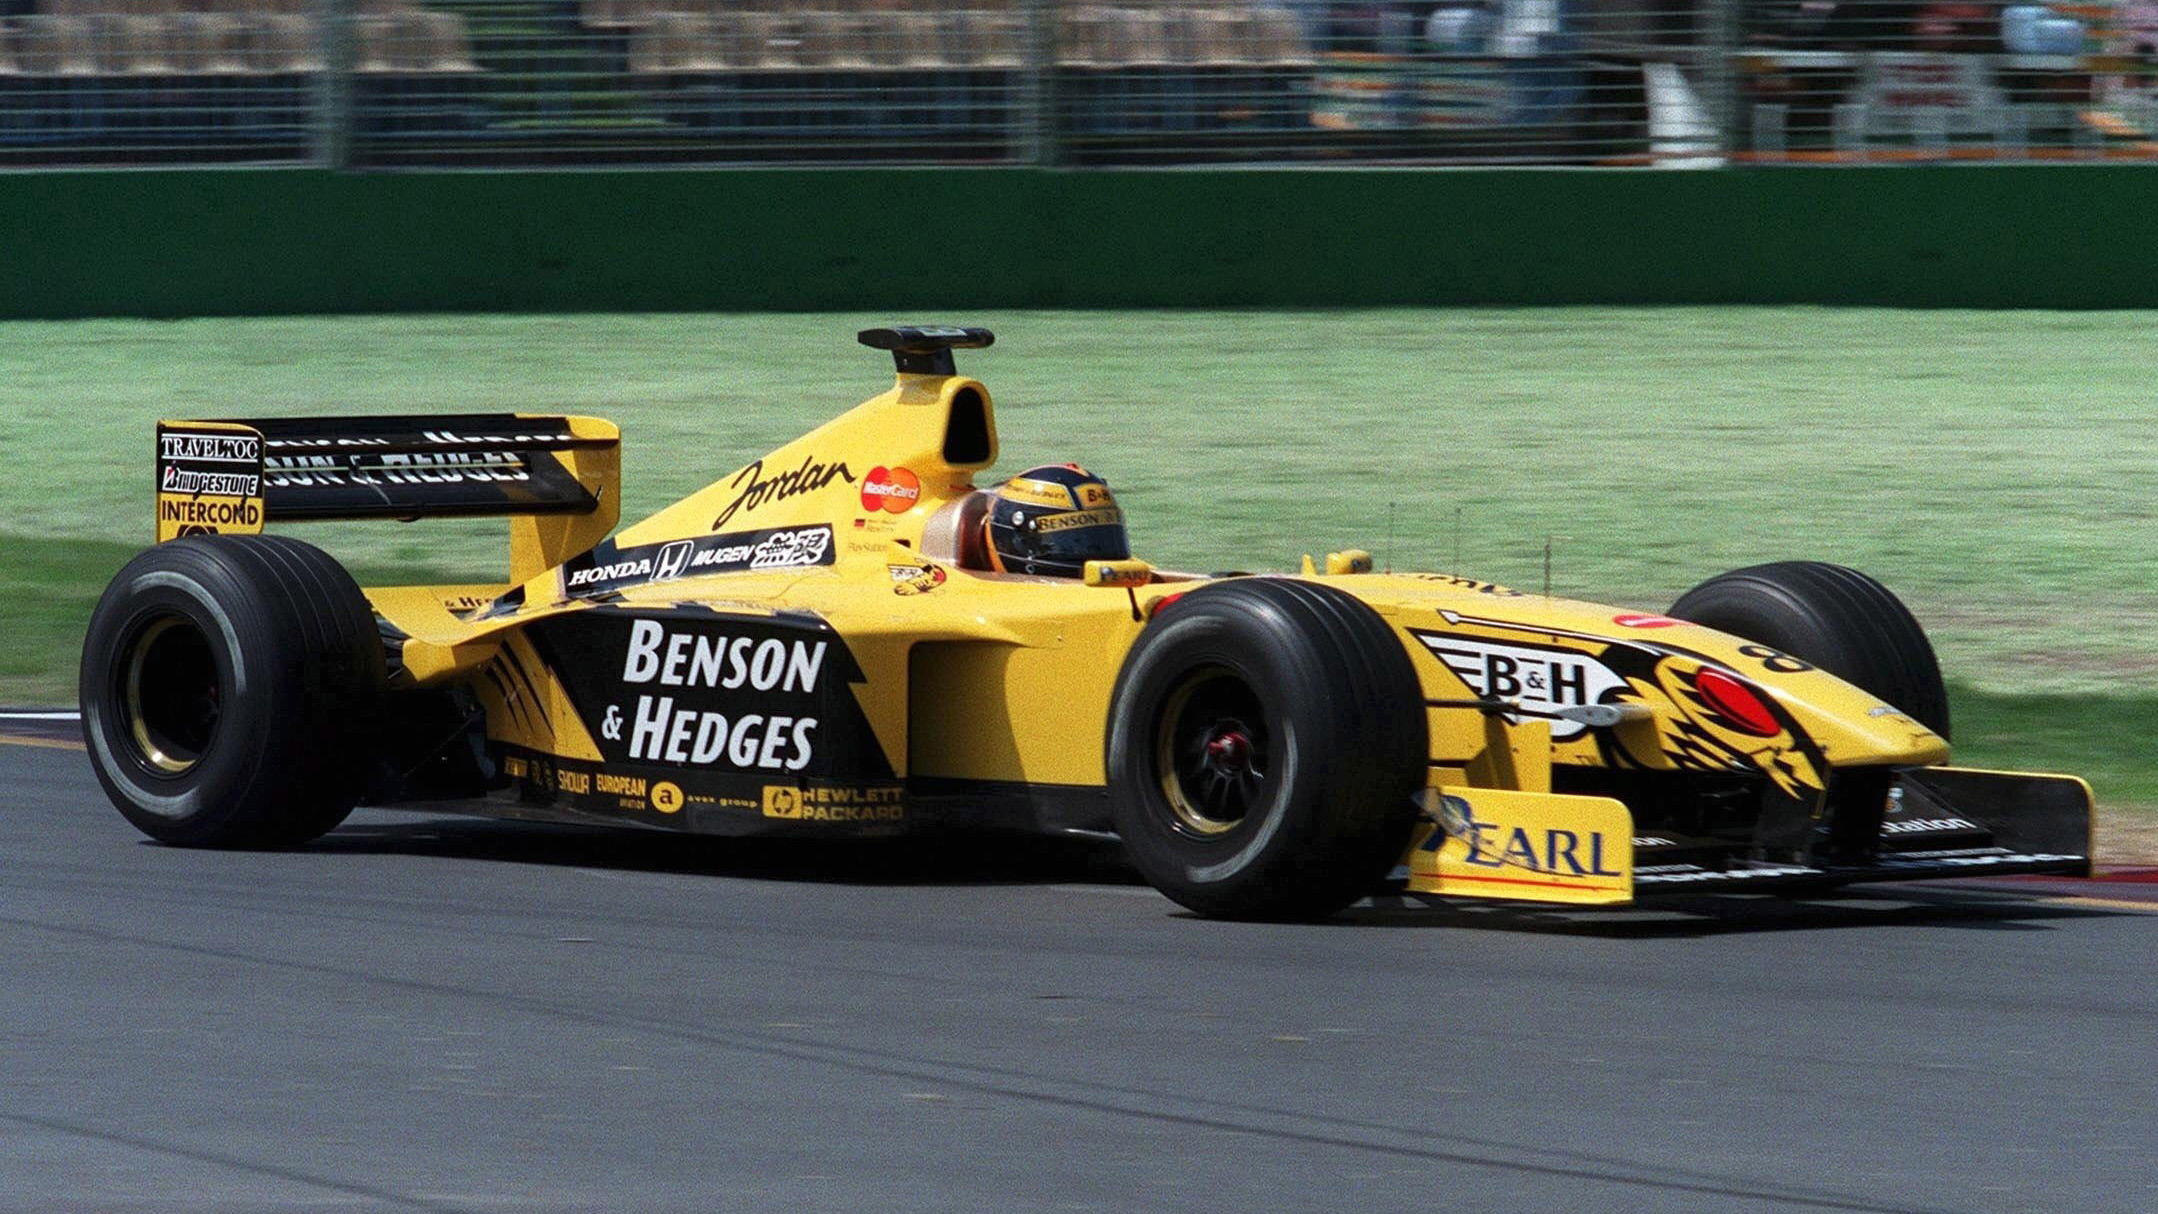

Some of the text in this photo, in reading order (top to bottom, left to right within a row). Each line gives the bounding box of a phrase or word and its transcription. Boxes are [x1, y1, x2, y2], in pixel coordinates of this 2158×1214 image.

[162, 466, 259, 496] BRIDGESTONE
[712, 455, 858, 531] Jordan
[863, 481, 919, 499] MasterCard
[162, 500, 259, 525] INTERCOND
[1039, 513, 1099, 531] BENSON
[568, 559, 651, 586] HONDA
[691, 544, 754, 567] MUGEN
[623, 619, 828, 693] BENSON
[1739, 645, 1815, 673] 8
[601, 695, 818, 770] & HEDGES
[557, 769, 590, 795] SHOWA
[596, 774, 646, 797] EUROPEAN
[720, 797, 758, 809] group
[803, 787, 903, 803] HEWLETT
[803, 806, 904, 821] PACKARD
